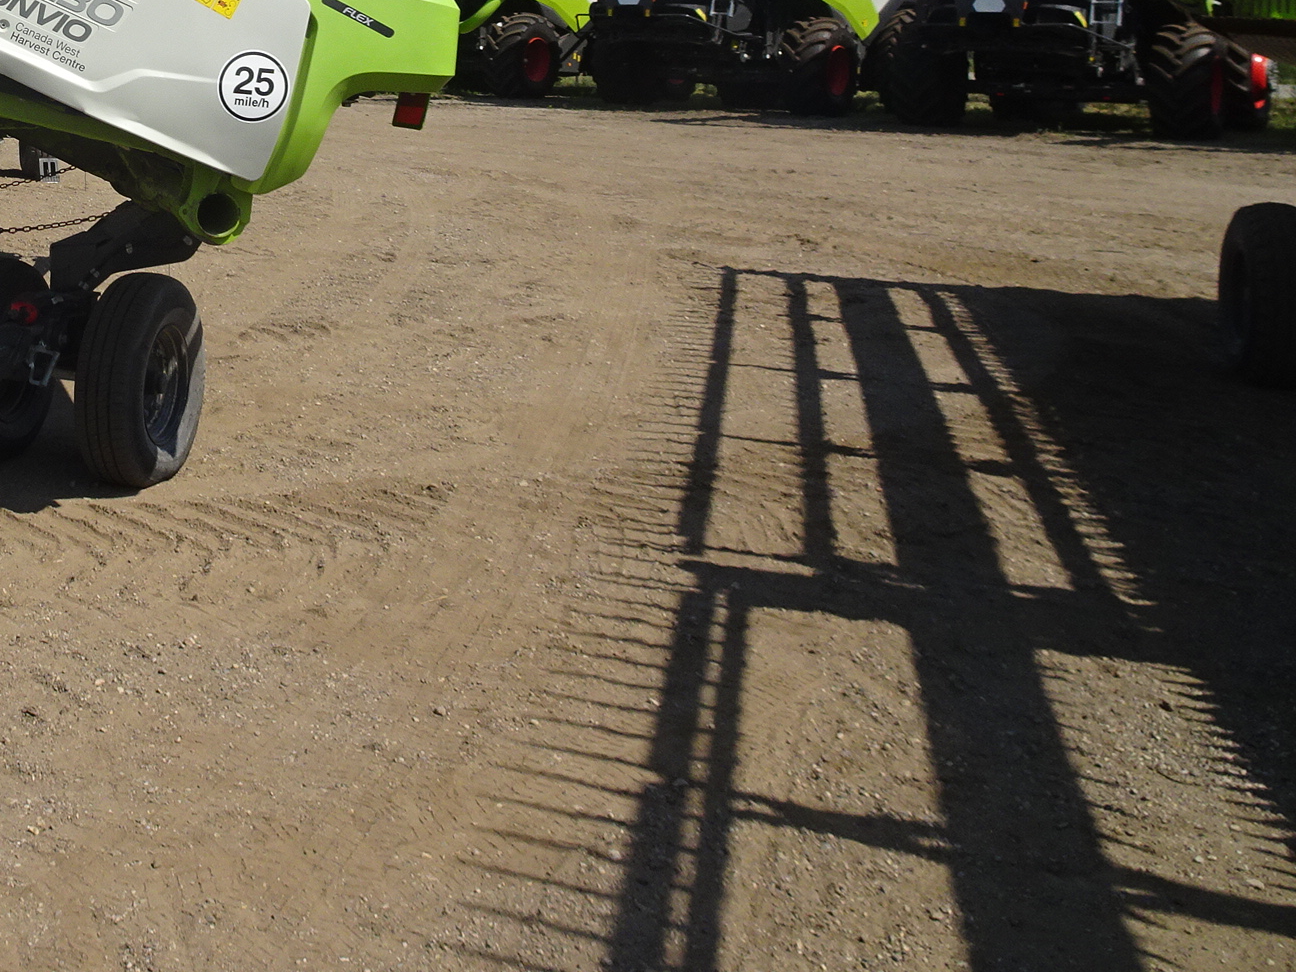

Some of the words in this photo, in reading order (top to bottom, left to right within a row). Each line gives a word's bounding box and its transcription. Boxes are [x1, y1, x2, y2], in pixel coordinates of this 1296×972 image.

[342, 7, 374, 26] FLEX
[10, 31, 51, 56] Harvest
[52, 50, 86, 72] Centre
[15, 22, 53, 46] Canada
[56, 39, 81, 58] West
[233, 66, 275, 97] 25
[234, 97, 269, 108] mile/h
